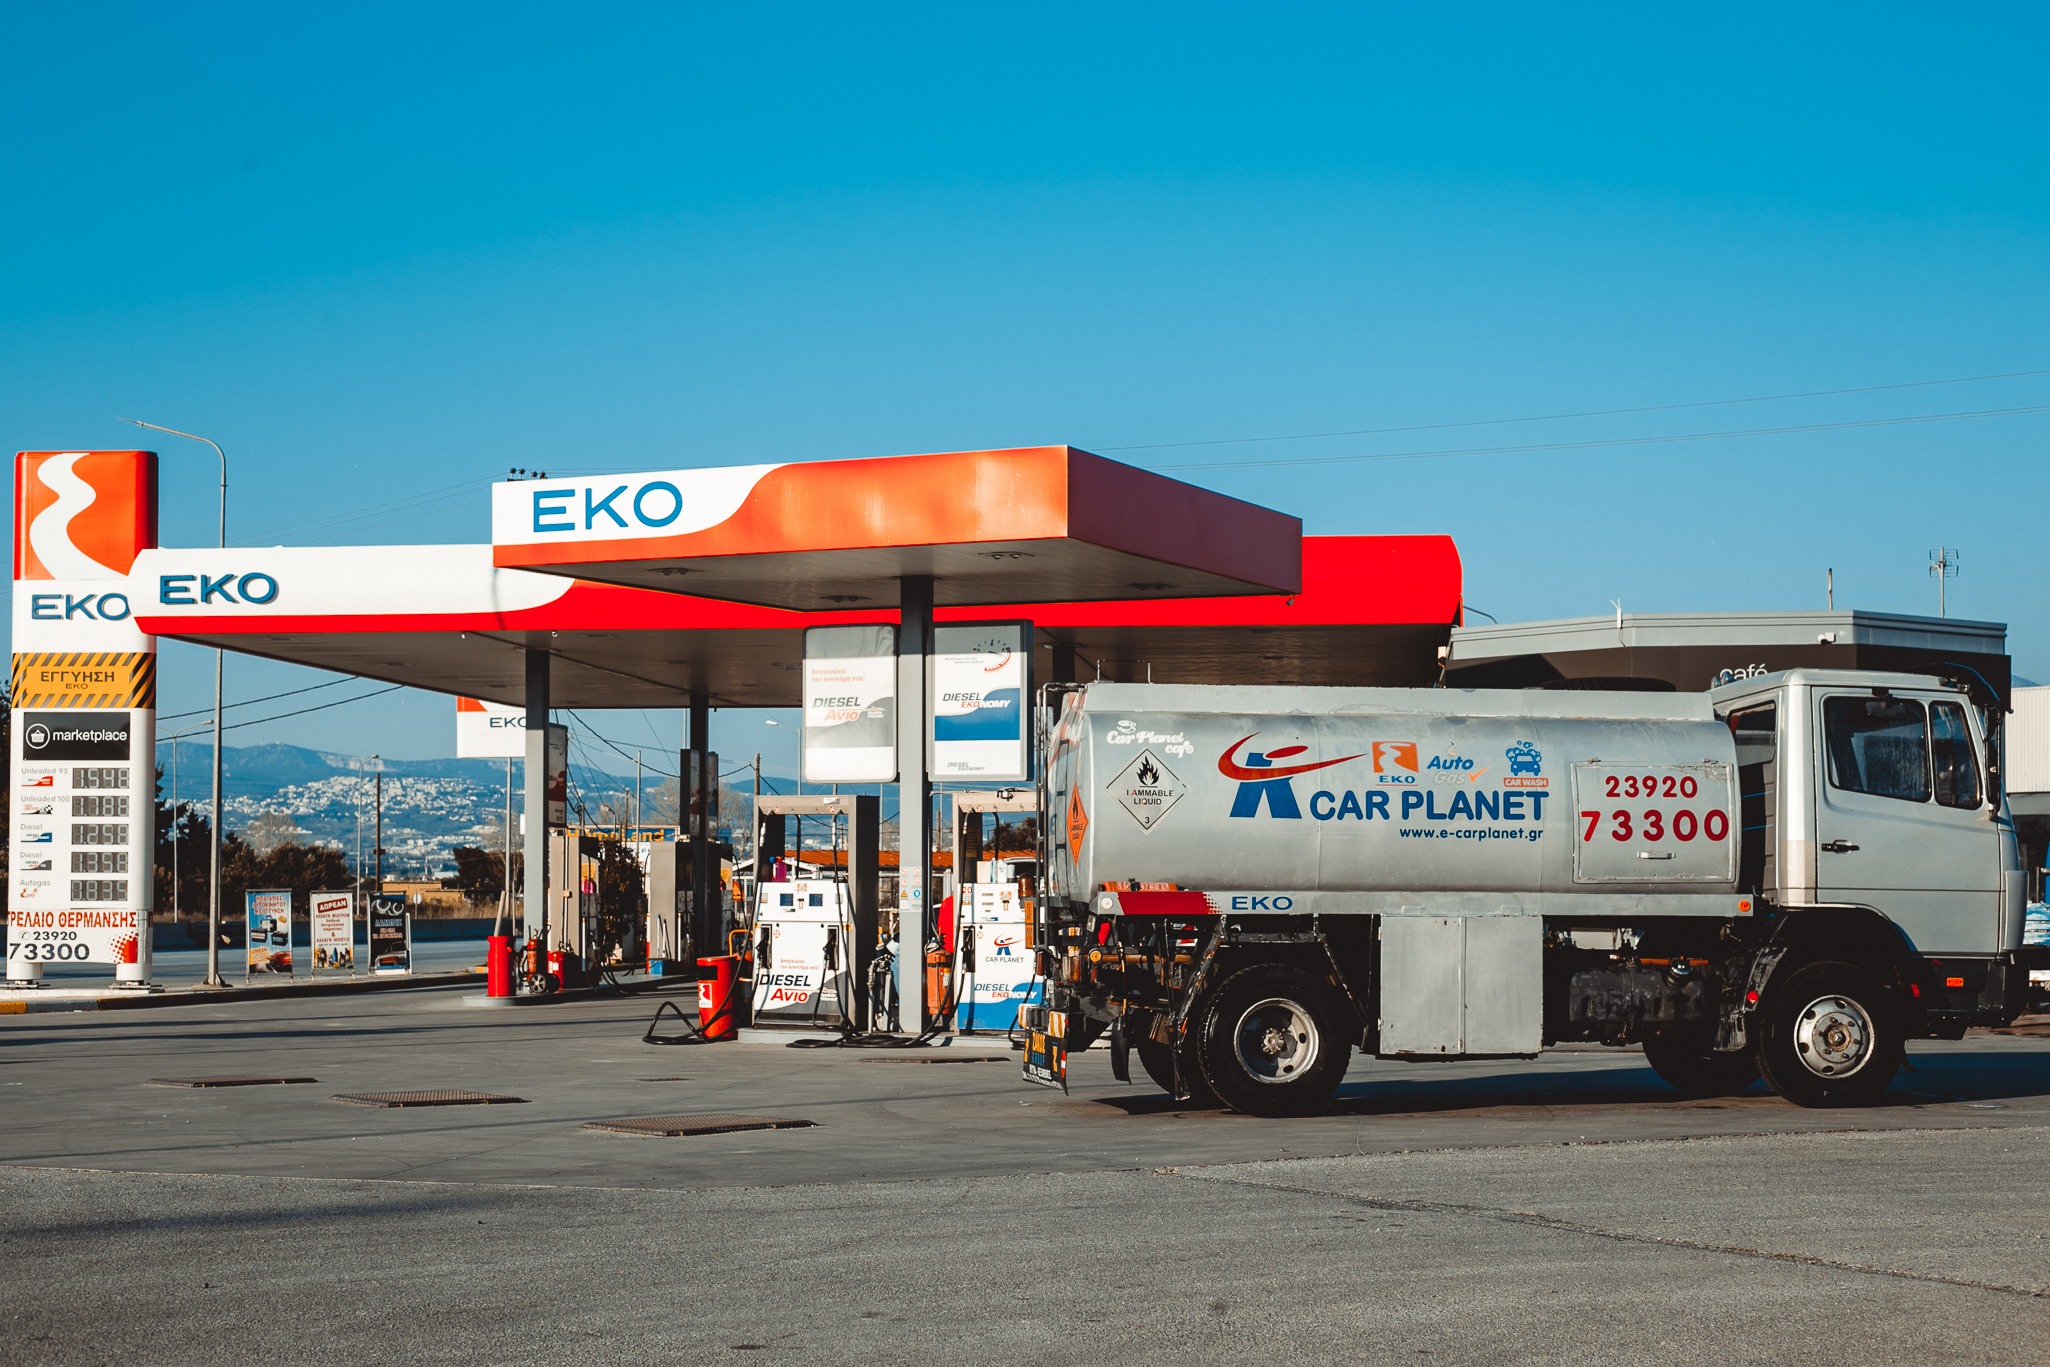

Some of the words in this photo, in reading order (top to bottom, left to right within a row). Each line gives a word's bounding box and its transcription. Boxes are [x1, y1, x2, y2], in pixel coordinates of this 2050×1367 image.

[533, 480, 683, 533] EKO
[160, 572, 278, 604] EKO
[32, 593, 130, 620] EKO
[41, 671, 115, 682] ΕΓΓΥΗΣΗ
[813, 696, 861, 708] DIESEL
[943, 692, 982, 702] DIESEL
[961, 700, 1011, 709] EKONOMY
[52, 729, 128, 743] marketplace
[1106, 730, 1136, 745] Car
[1427, 755, 1474, 770] Auto
[1379, 775, 1416, 784] EKO
[1433, 770, 1466, 785] Gas
[1505, 779, 1521, 787] CAR
[1522, 779, 1548, 787] WASH
[1606, 775, 1698, 799] 23920
[1310, 790, 1390, 821] CAR
[1402, 790, 1550, 821] PLANET
[20, 823, 43, 831] Diesel
[1144, 816, 1150, 824] 3
[1581, 809, 1729, 842] 73300
[1400, 827, 1543, 842] www.e-carplanet.gr
[20, 851, 43, 859] Diesel
[319, 900, 347, 910] ΔΩΡΕΑΝ
[1231, 896, 1293, 911] EKO
[58, 911, 137, 928] ΘΕΡΜΑΝΣΗΣ
[33, 931, 77, 941] 23920
[9, 942, 90, 961] 73300
[759, 975, 811, 987] DIESEL
[974, 983, 1010, 992] DIESEL
